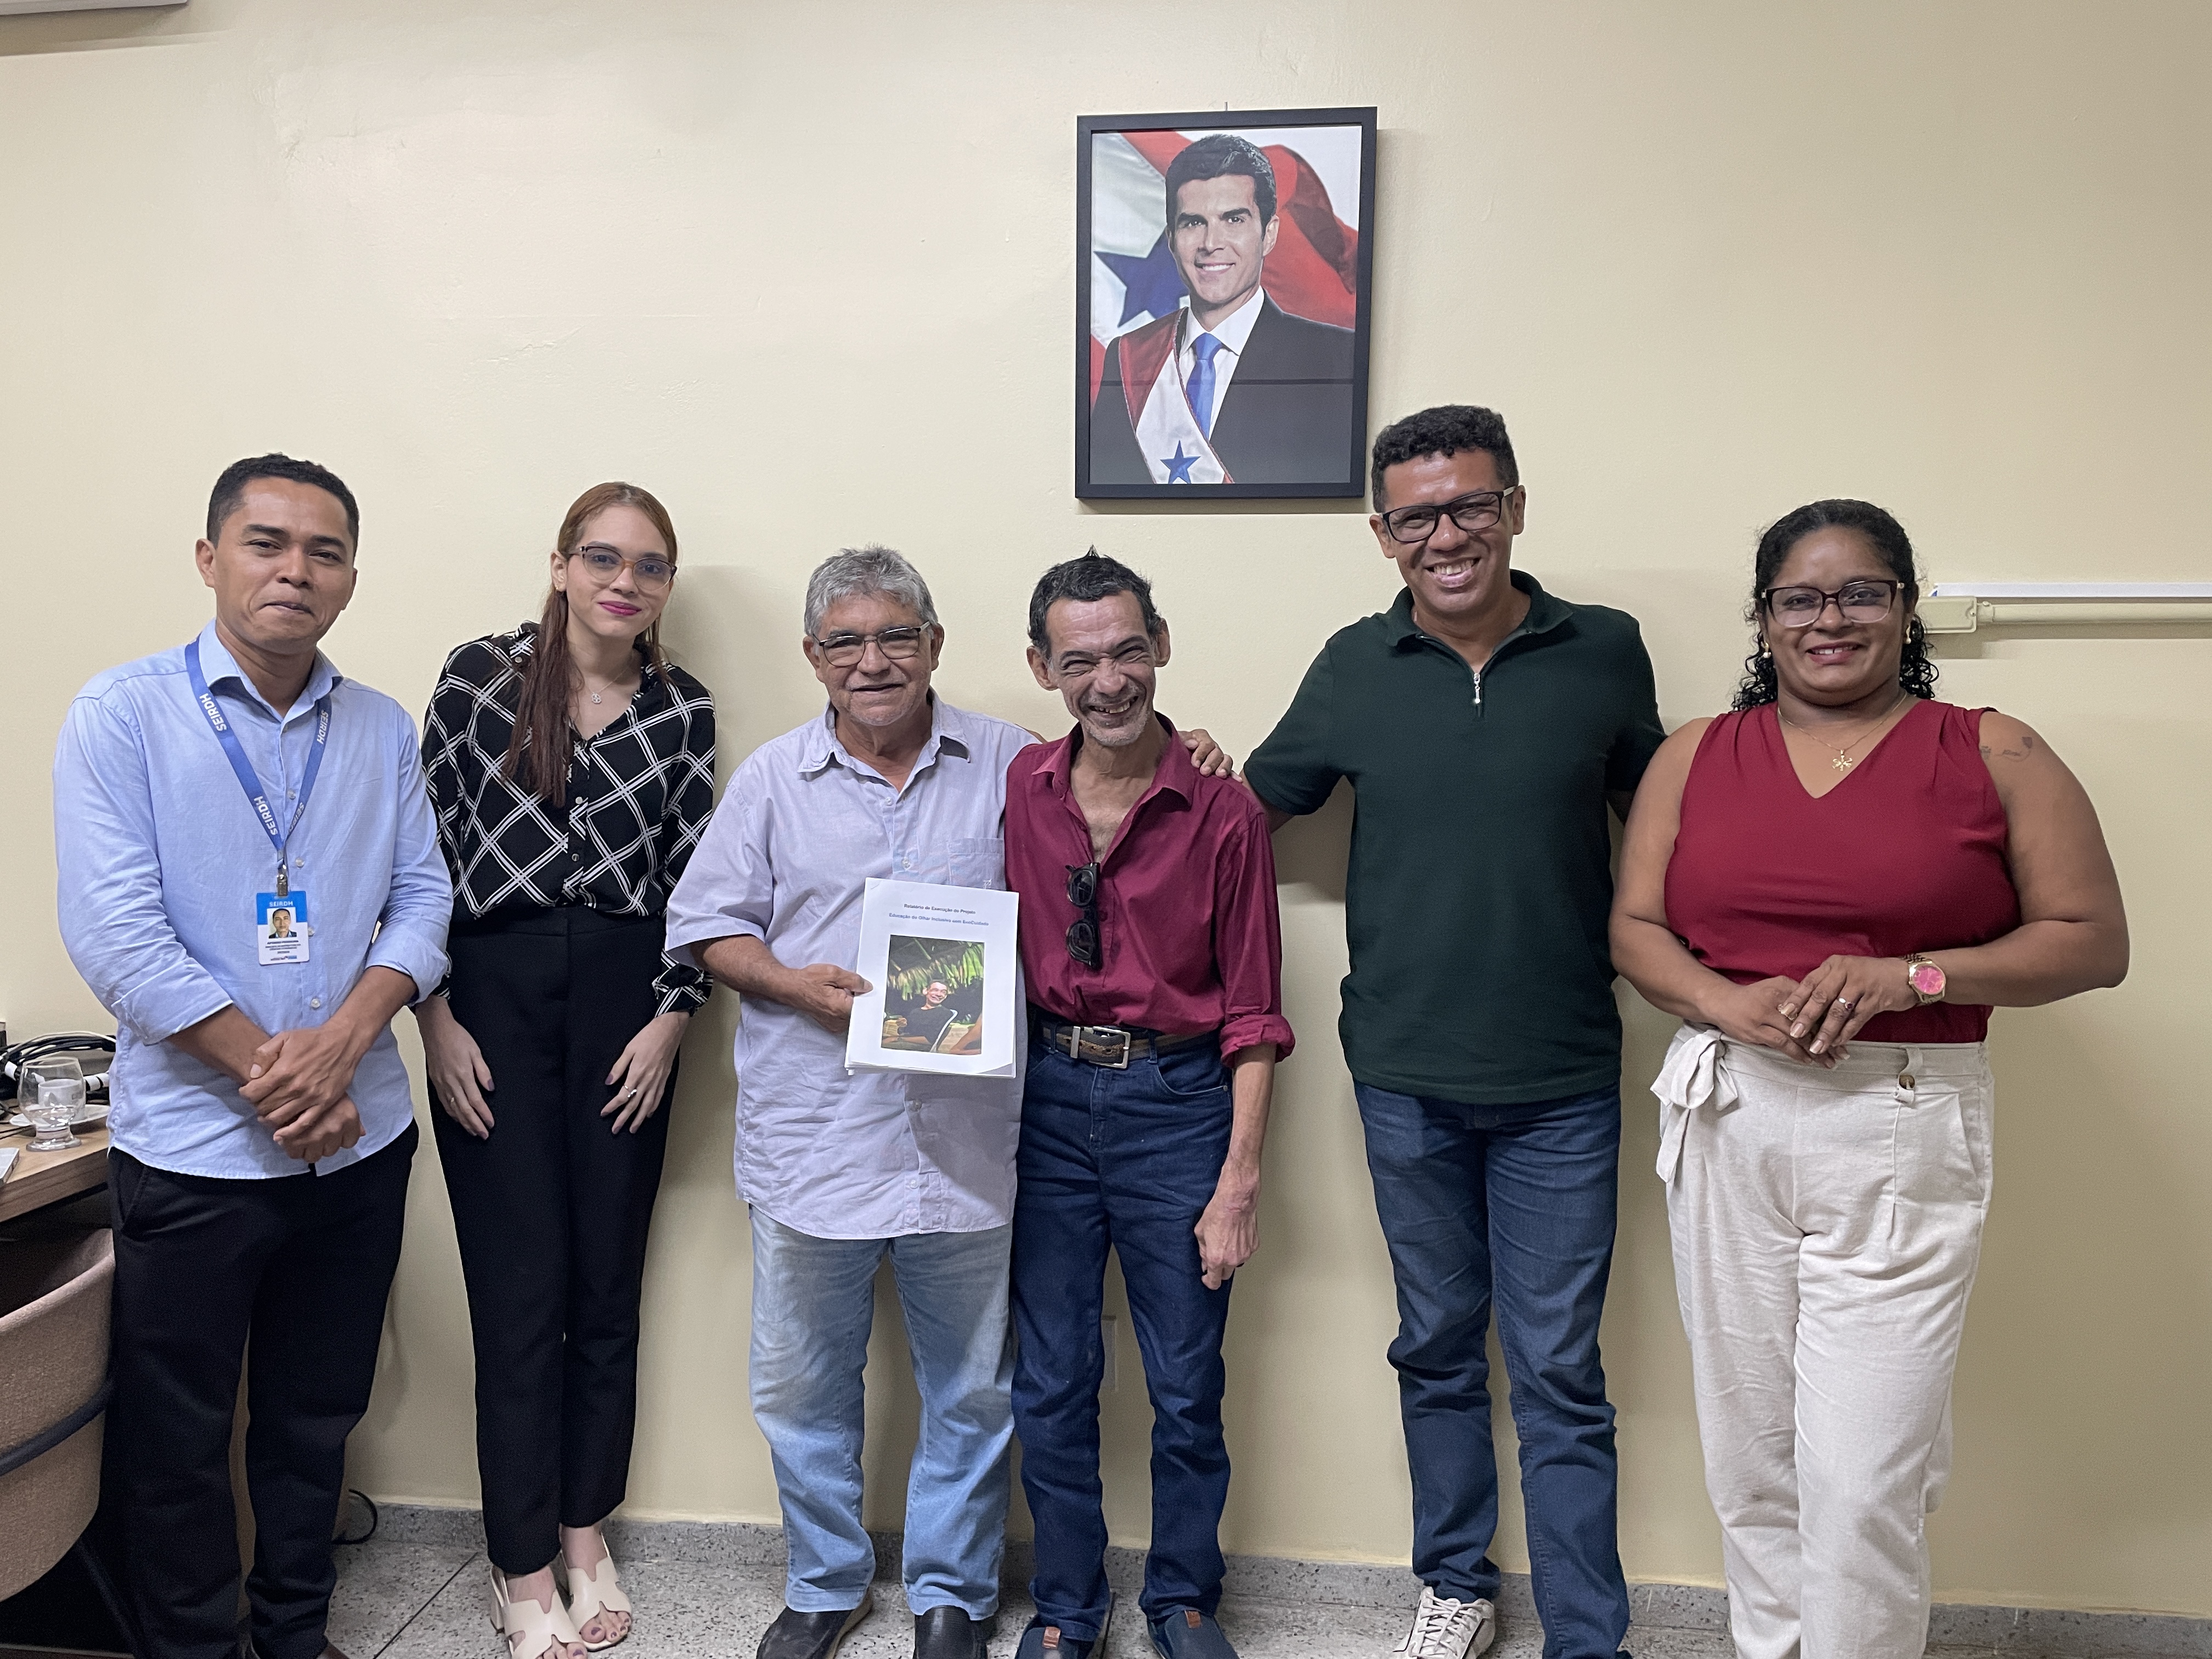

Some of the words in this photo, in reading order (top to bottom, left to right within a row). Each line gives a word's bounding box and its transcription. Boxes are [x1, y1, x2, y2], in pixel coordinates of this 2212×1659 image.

[199, 693, 227, 731] SEIRDH
[317, 709, 329, 744] SEIRDH
[254, 795, 278, 835] SEIRDH
